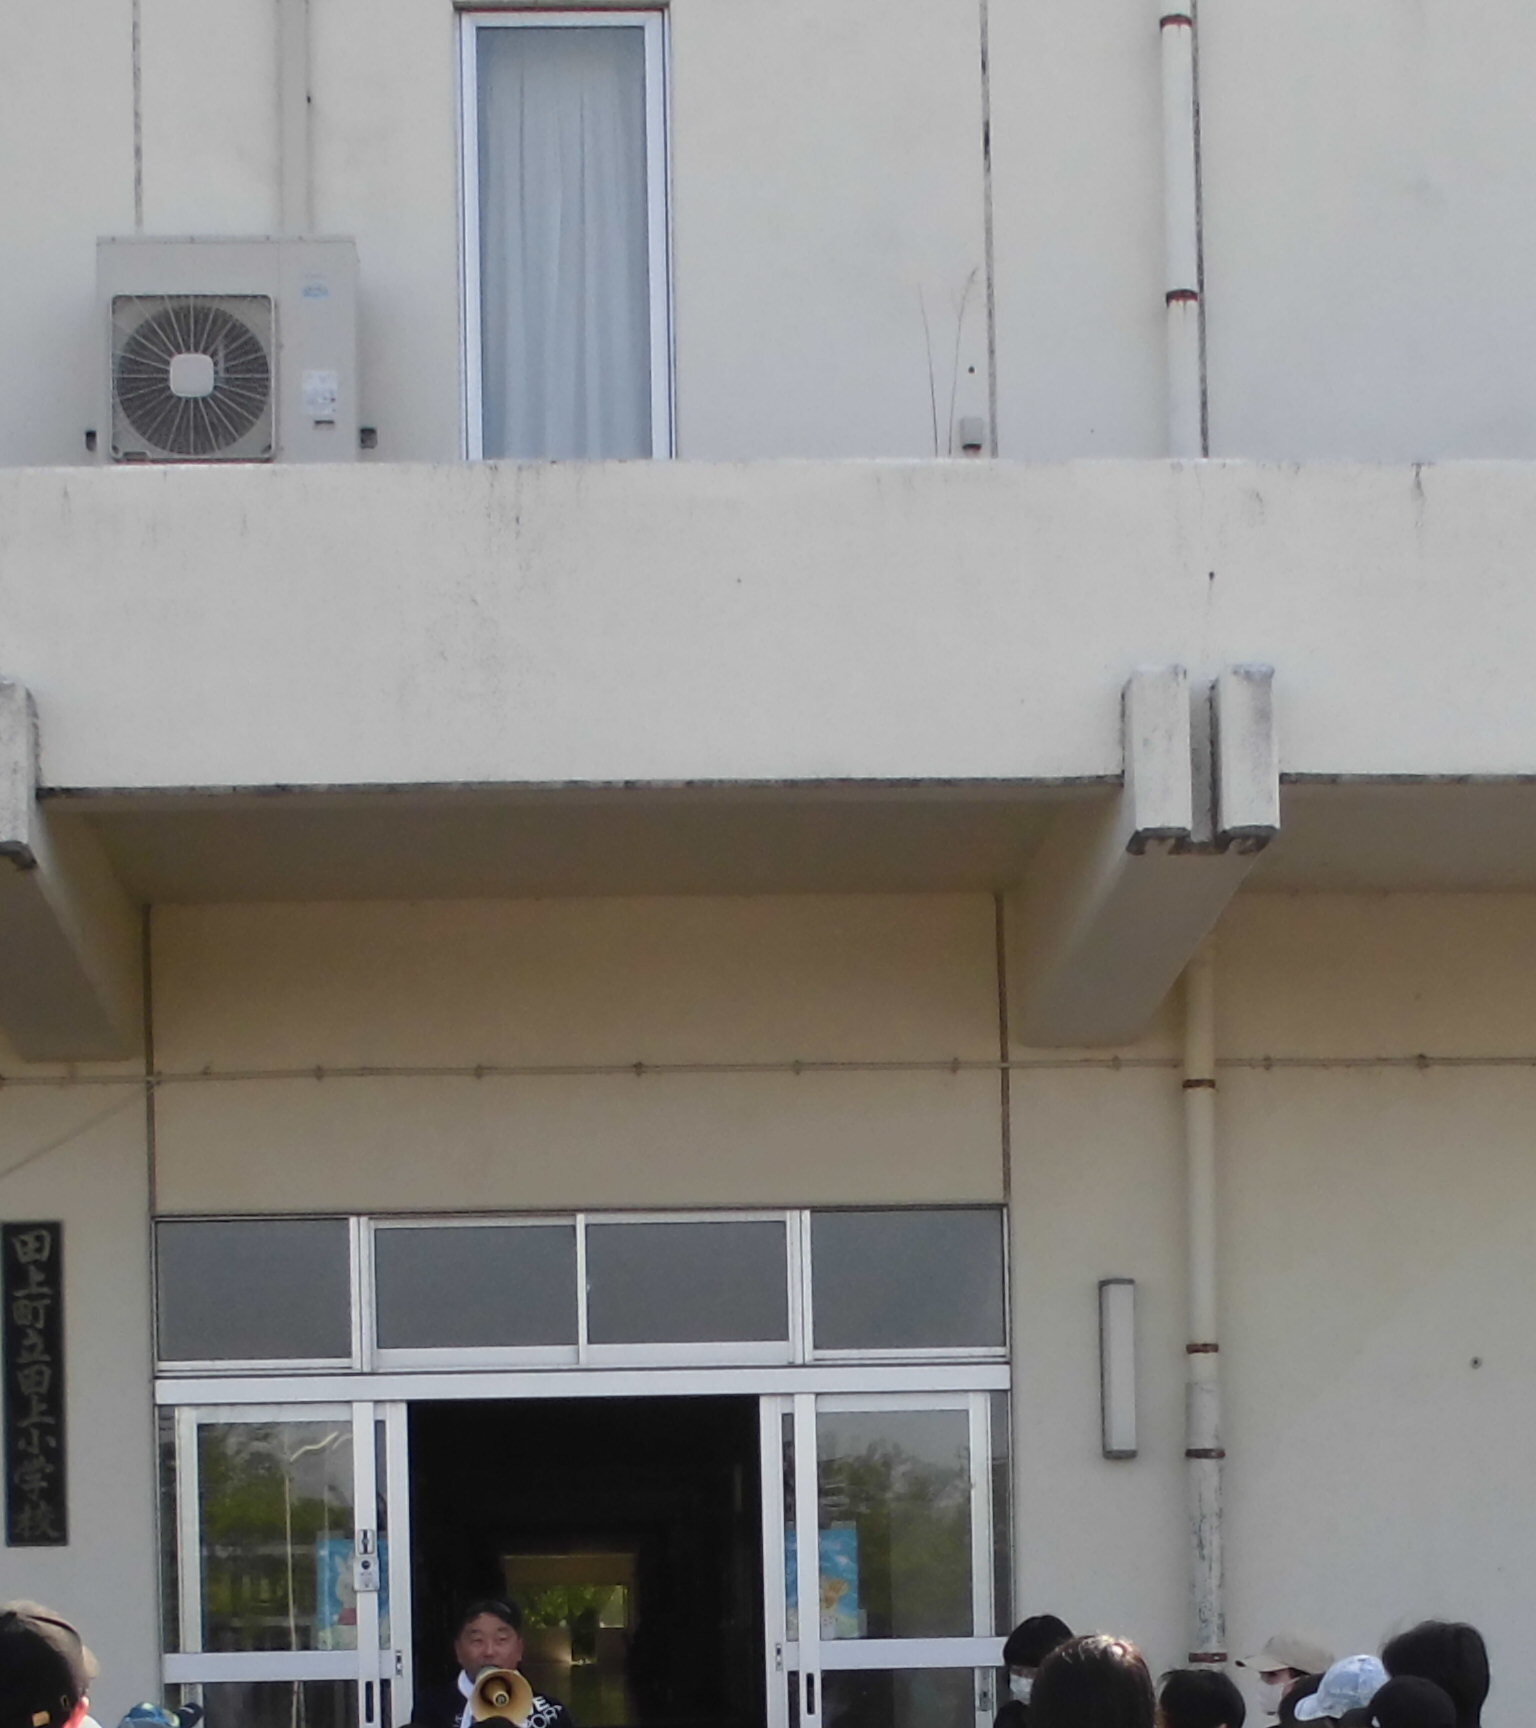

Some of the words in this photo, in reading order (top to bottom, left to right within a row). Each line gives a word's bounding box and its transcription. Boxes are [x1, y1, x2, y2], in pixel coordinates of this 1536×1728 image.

[13, 1229, 60, 1539] 田上町立田上小学校
